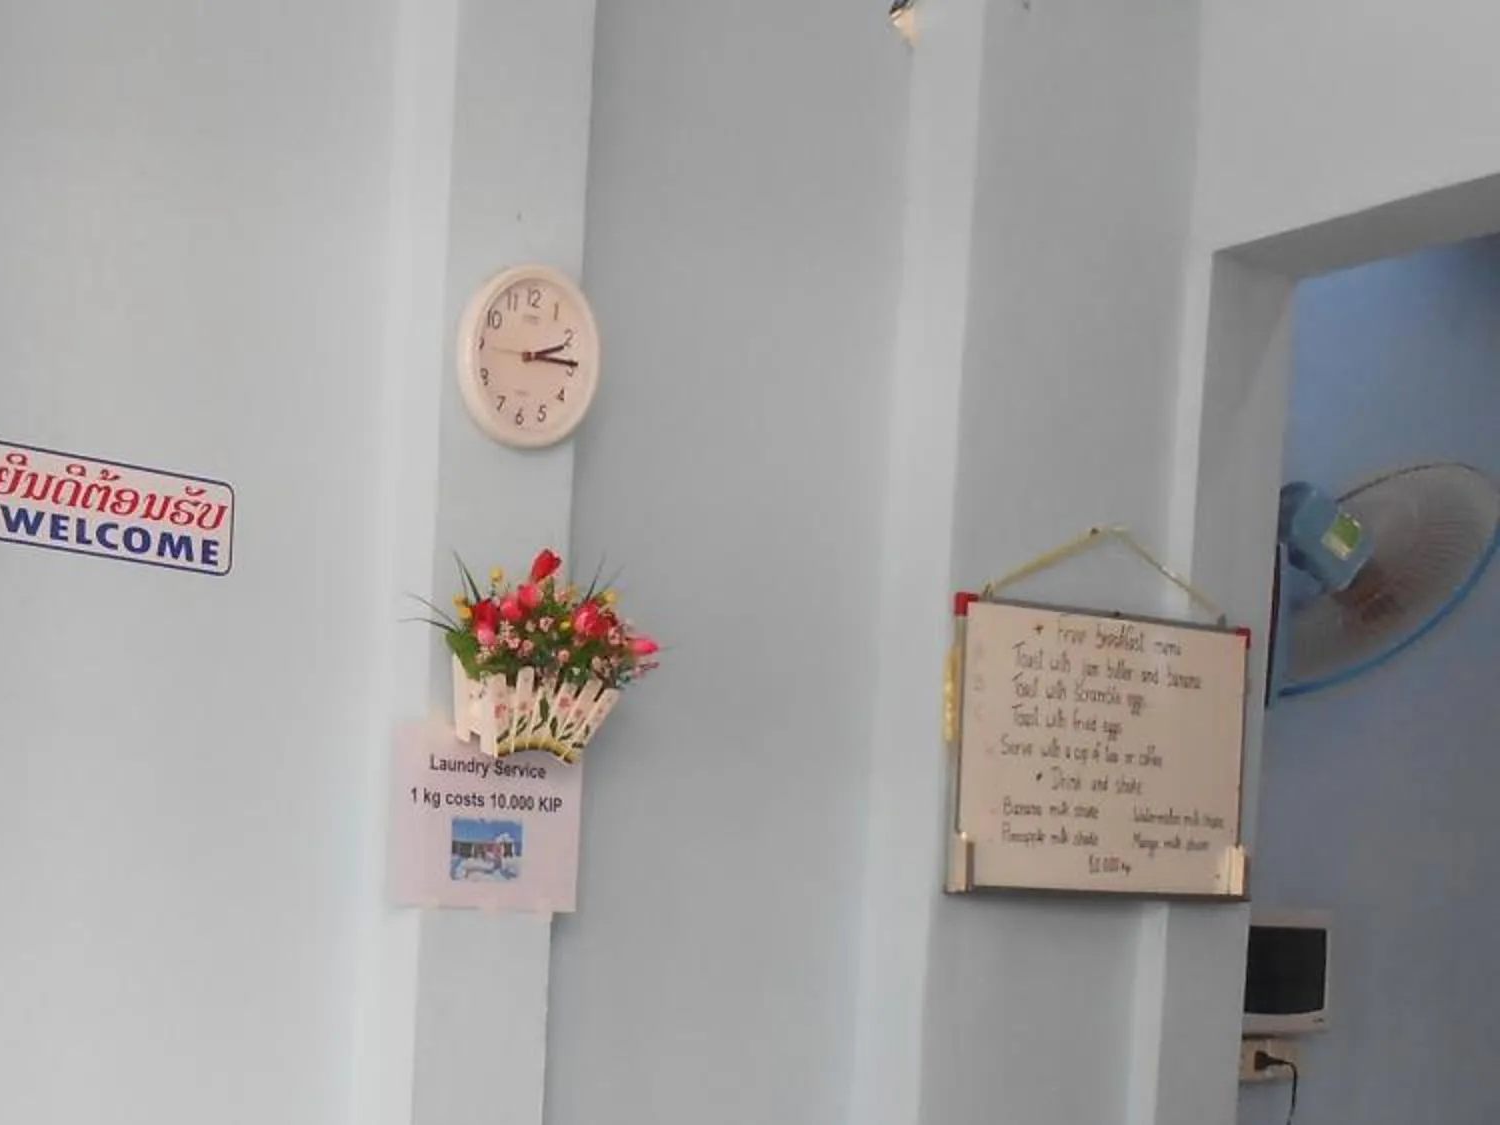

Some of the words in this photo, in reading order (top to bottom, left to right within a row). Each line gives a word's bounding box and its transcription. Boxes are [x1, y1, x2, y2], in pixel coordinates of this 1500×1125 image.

[507, 289, 518, 311] 11
[527, 286, 541, 309] 12
[488, 310, 502, 329] 10
[554, 302, 559, 321] 1
[564, 328, 574, 347] 2
[496, 395, 506, 412] 7
[537, 404, 547, 422] 5
[515, 408, 524, 425] 6
[0, 503, 220, 566] WELCOME
[430, 754, 490, 779] Laundry
[493, 760, 547, 780] Service
[411, 787, 418, 805] 1
[423, 788, 441, 809] kg
[445, 792, 485, 808] costs
[538, 797, 563, 813] KIP
